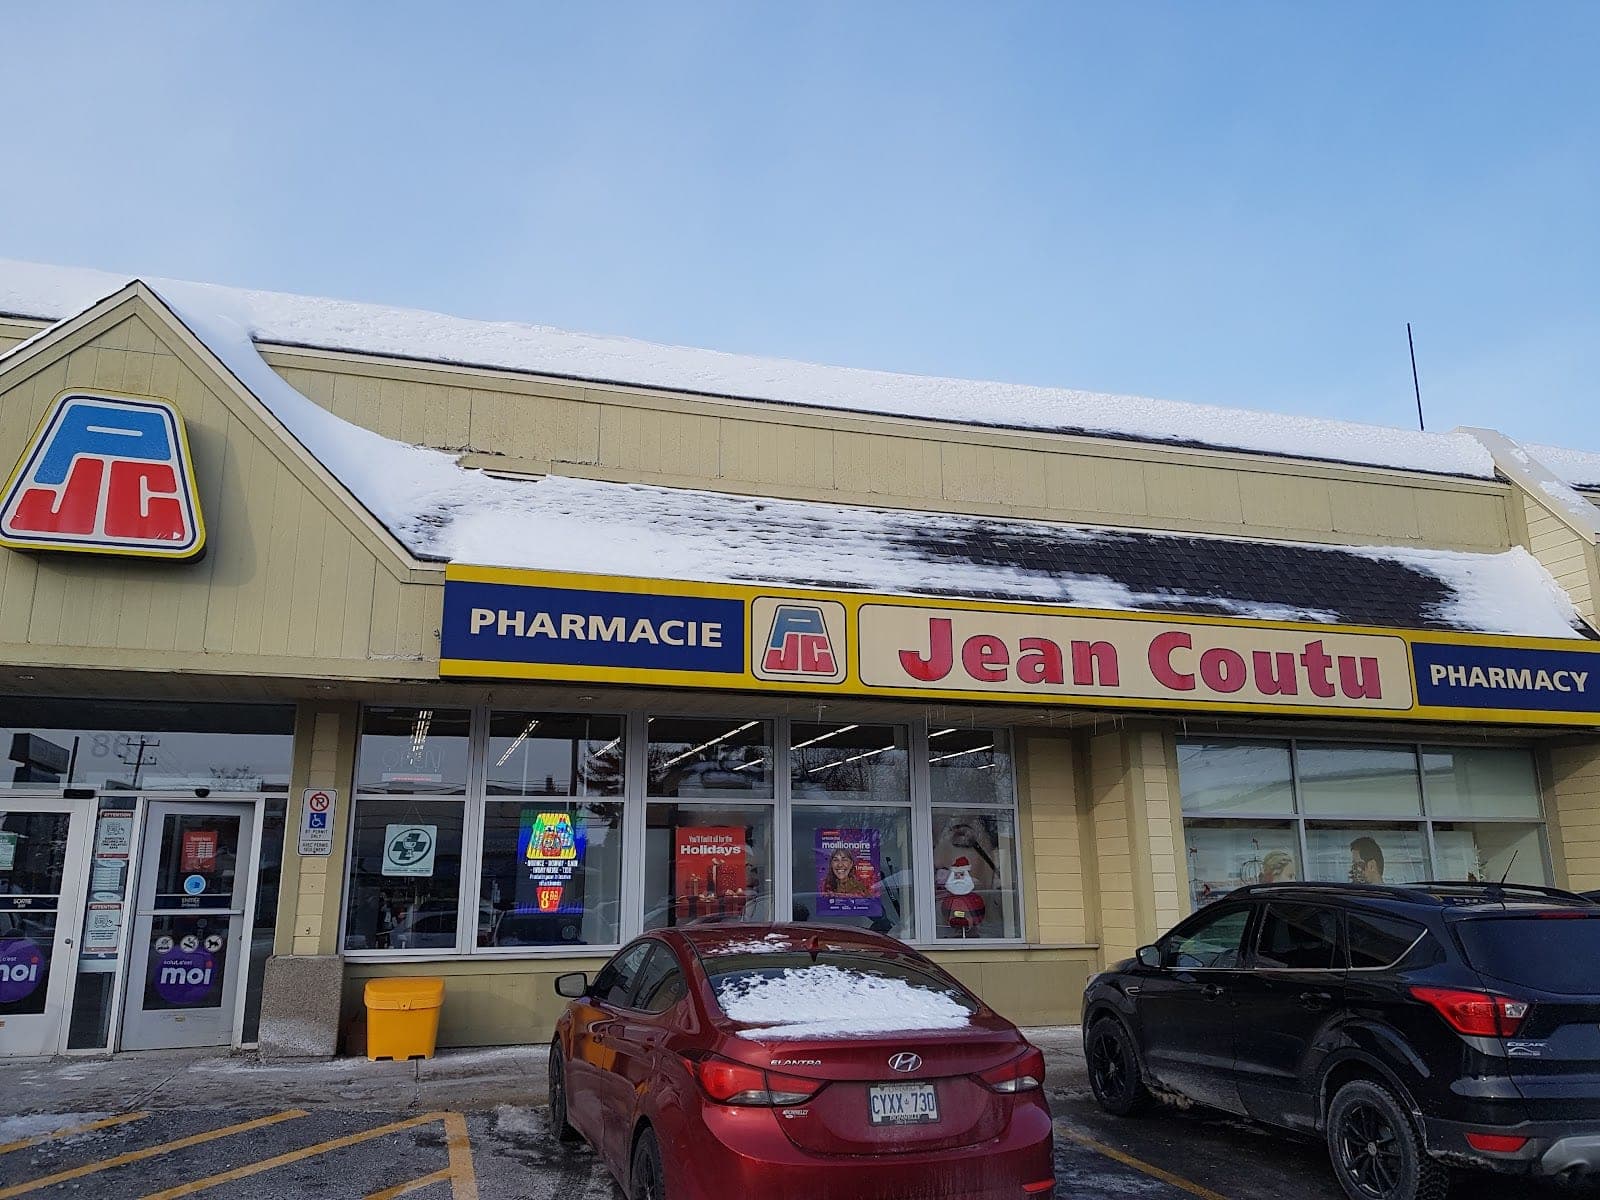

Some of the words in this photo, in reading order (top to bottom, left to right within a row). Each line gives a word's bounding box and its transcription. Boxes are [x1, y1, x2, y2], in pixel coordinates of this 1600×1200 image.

[469, 608, 723, 648] PHARMACIE
[898, 618, 1120, 687] Jean
[1147, 630, 1383, 700] Coutu
[1430, 663, 1589, 693] PHARMACY
[680, 844, 741, 856] Holidays
[160, 960, 213, 985] moi
[872, 1093, 904, 1115] CYXX
